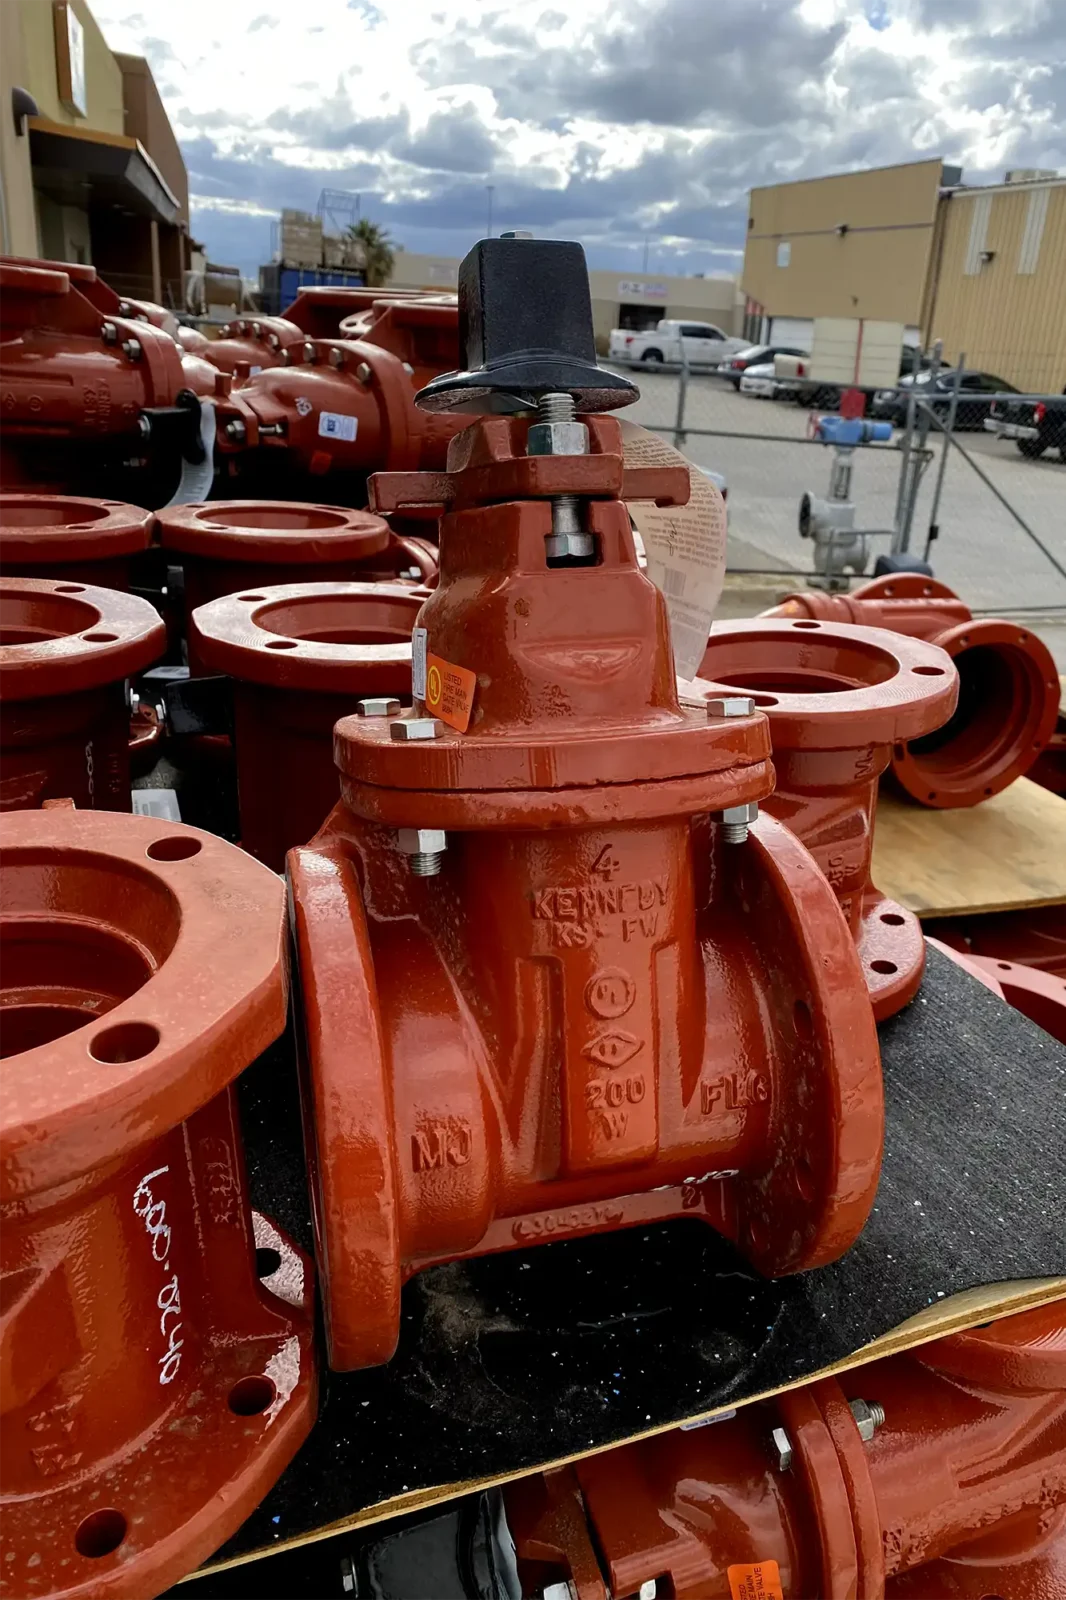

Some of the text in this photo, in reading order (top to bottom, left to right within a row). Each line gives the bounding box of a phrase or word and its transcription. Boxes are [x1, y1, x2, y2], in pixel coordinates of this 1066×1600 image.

[443, 671, 462, 686] LISTED
[443, 682, 468, 701] FIRE MAIN
[442, 692, 456, 706] GATE
[456, 699, 470, 714] VALVE
[591, 843, 620, 882] 4
[529, 873, 669, 920] KENNEDY
[586, 1074, 646, 1111] 200
[701, 1069, 771, 1115] FLG
[753, 1566, 764, 1591] VALVE
